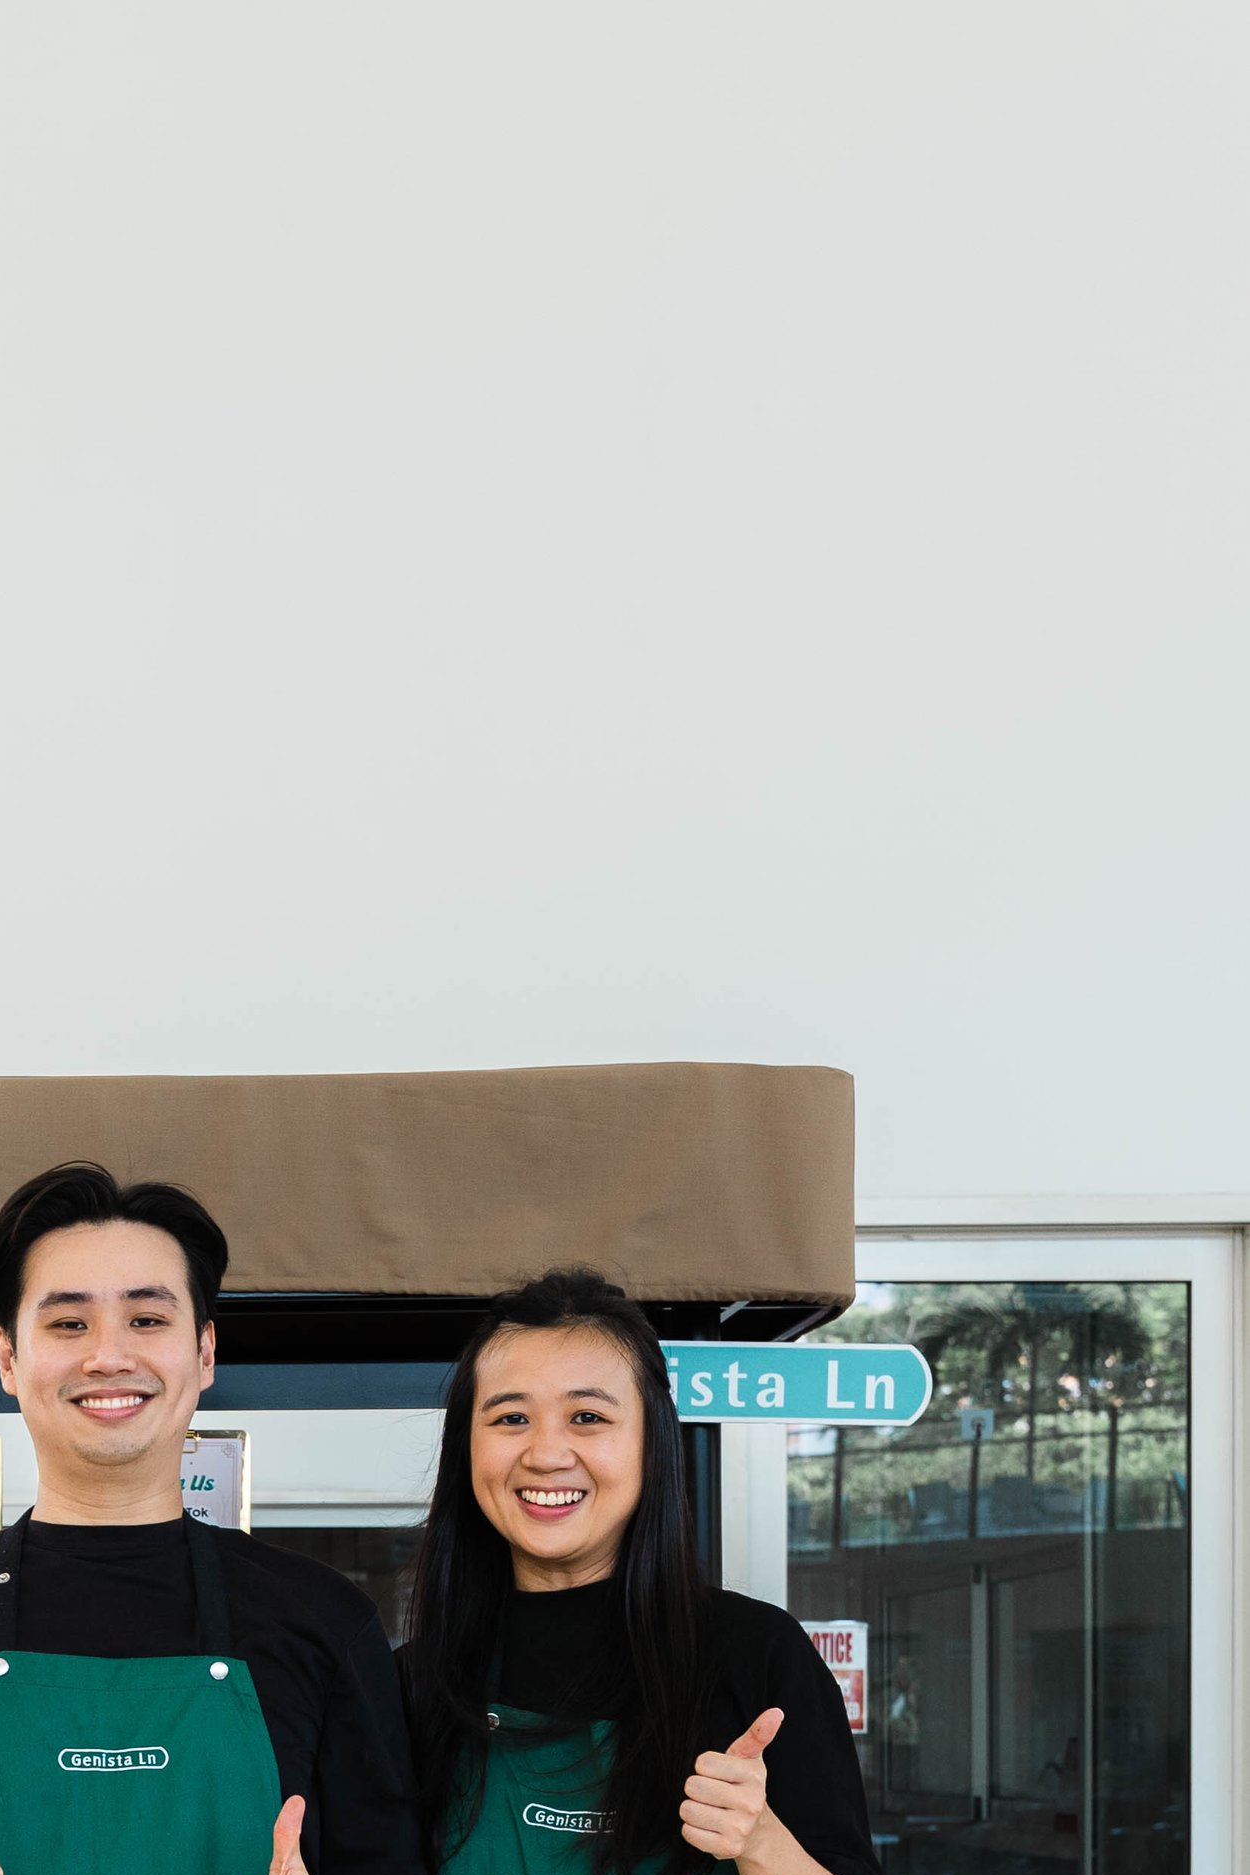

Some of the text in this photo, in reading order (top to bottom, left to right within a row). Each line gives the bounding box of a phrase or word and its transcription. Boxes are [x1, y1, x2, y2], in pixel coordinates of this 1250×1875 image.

[827, 1359, 895, 1410] Ln
[190, 1474, 215, 1491] Us
[810, 1632, 853, 1664] OTICE
[70, 1752, 157, 1767] Genista Ln
[535, 1810, 592, 1829] Genista
